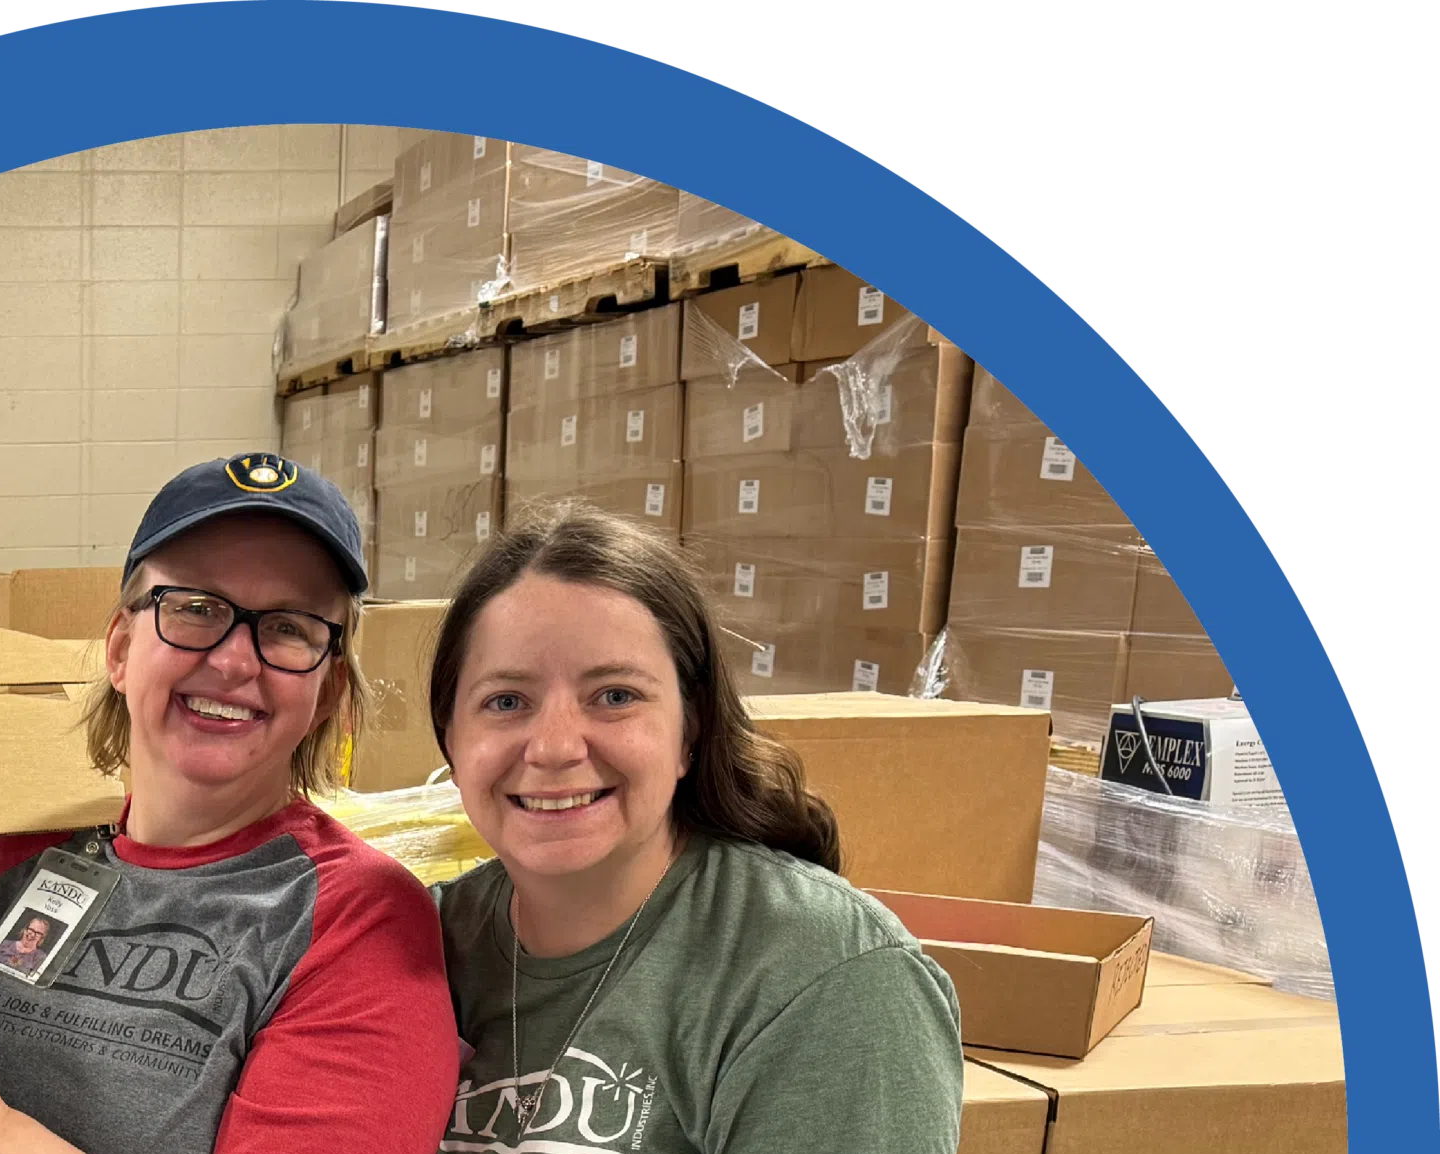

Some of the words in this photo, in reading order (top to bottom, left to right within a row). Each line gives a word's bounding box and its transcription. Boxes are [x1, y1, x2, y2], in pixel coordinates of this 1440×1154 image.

[1148, 734, 1205, 767] EMPLEX
[1167, 766, 1192, 781] 6000
[40, 880, 89, 905] KANDU
[3, 996, 40, 1015] JOBS
[40, 1007, 52, 1019] &
[54, 1009, 137, 1038] FULFILLING
[140, 1028, 213, 1059] DREAMS
[20, 1025, 96, 1053] CUSTOMERS
[97, 1044, 107, 1056] &
[111, 1048, 204, 1081] COMMUNITY
[450, 1072, 637, 1143] ANDU
